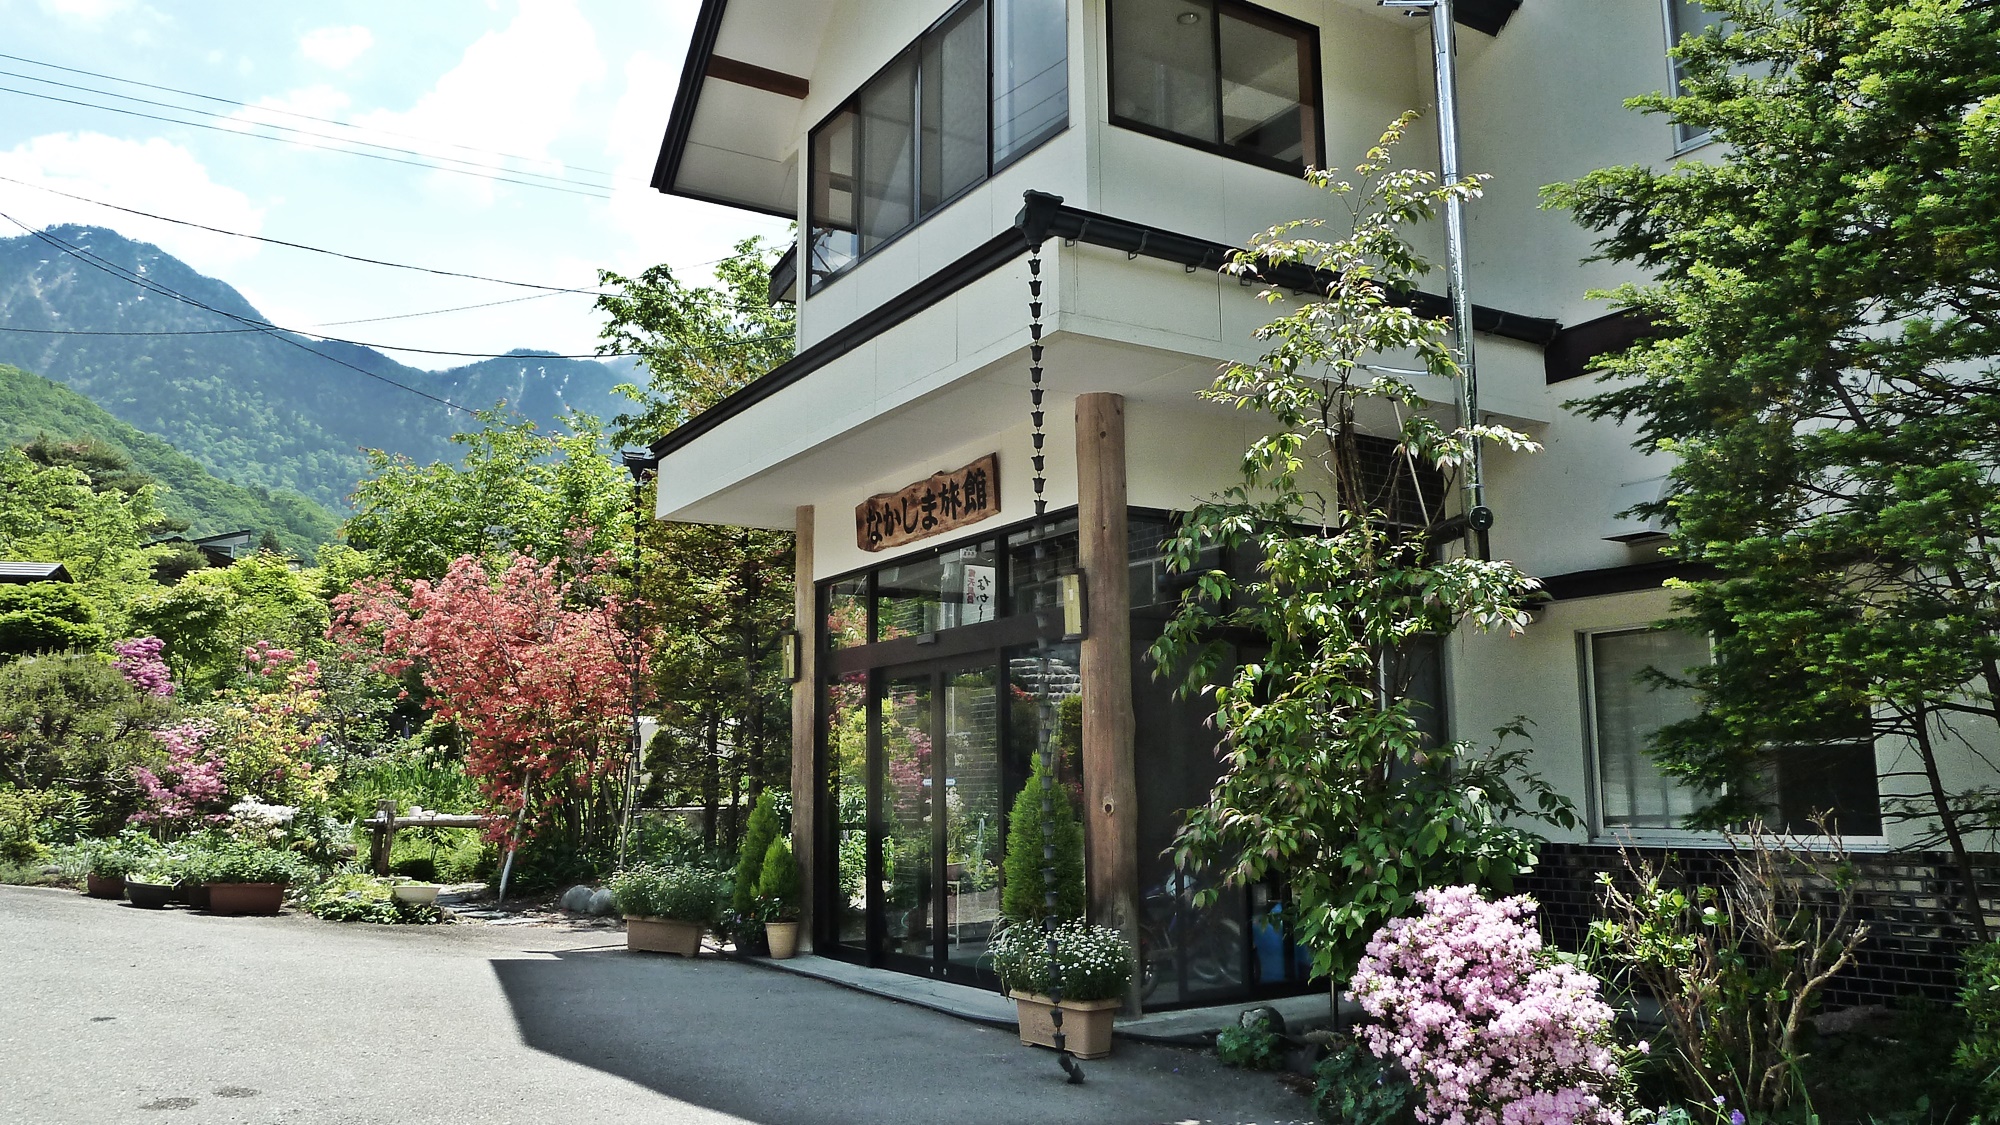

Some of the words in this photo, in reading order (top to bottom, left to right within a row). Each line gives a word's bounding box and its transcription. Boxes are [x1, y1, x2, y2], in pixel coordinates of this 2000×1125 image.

[866, 467, 987, 545] なかしま旅館
